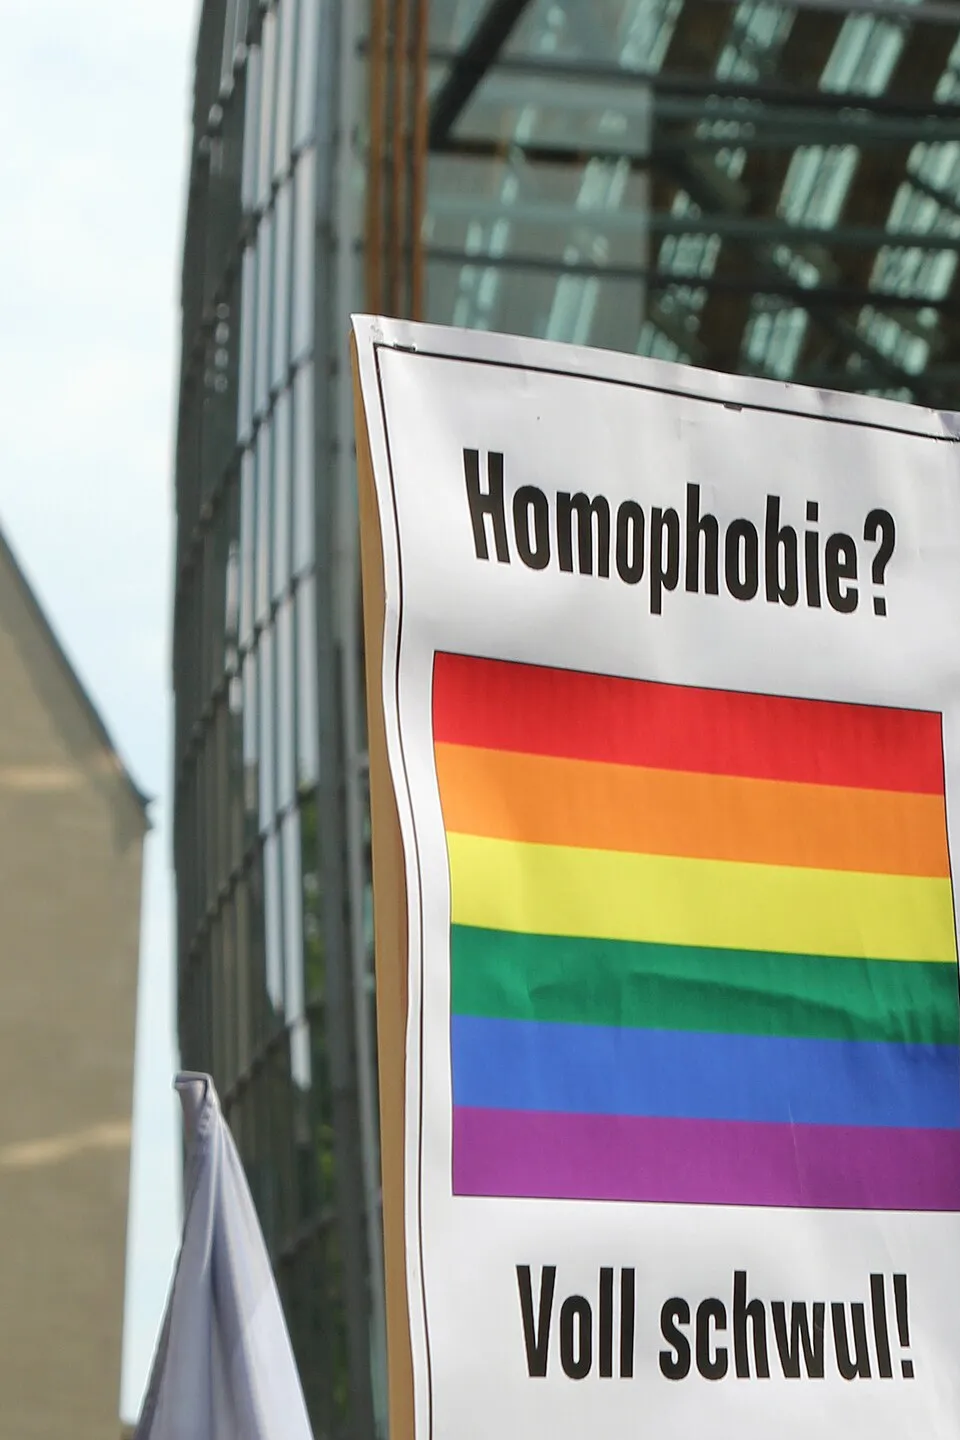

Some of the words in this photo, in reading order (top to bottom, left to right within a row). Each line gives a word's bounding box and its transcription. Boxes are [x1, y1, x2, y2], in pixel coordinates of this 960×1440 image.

[462, 447, 897, 617] Homophobie?
[515, 1264, 636, 1380] Voll
[658, 1269, 915, 1380] schwul!
